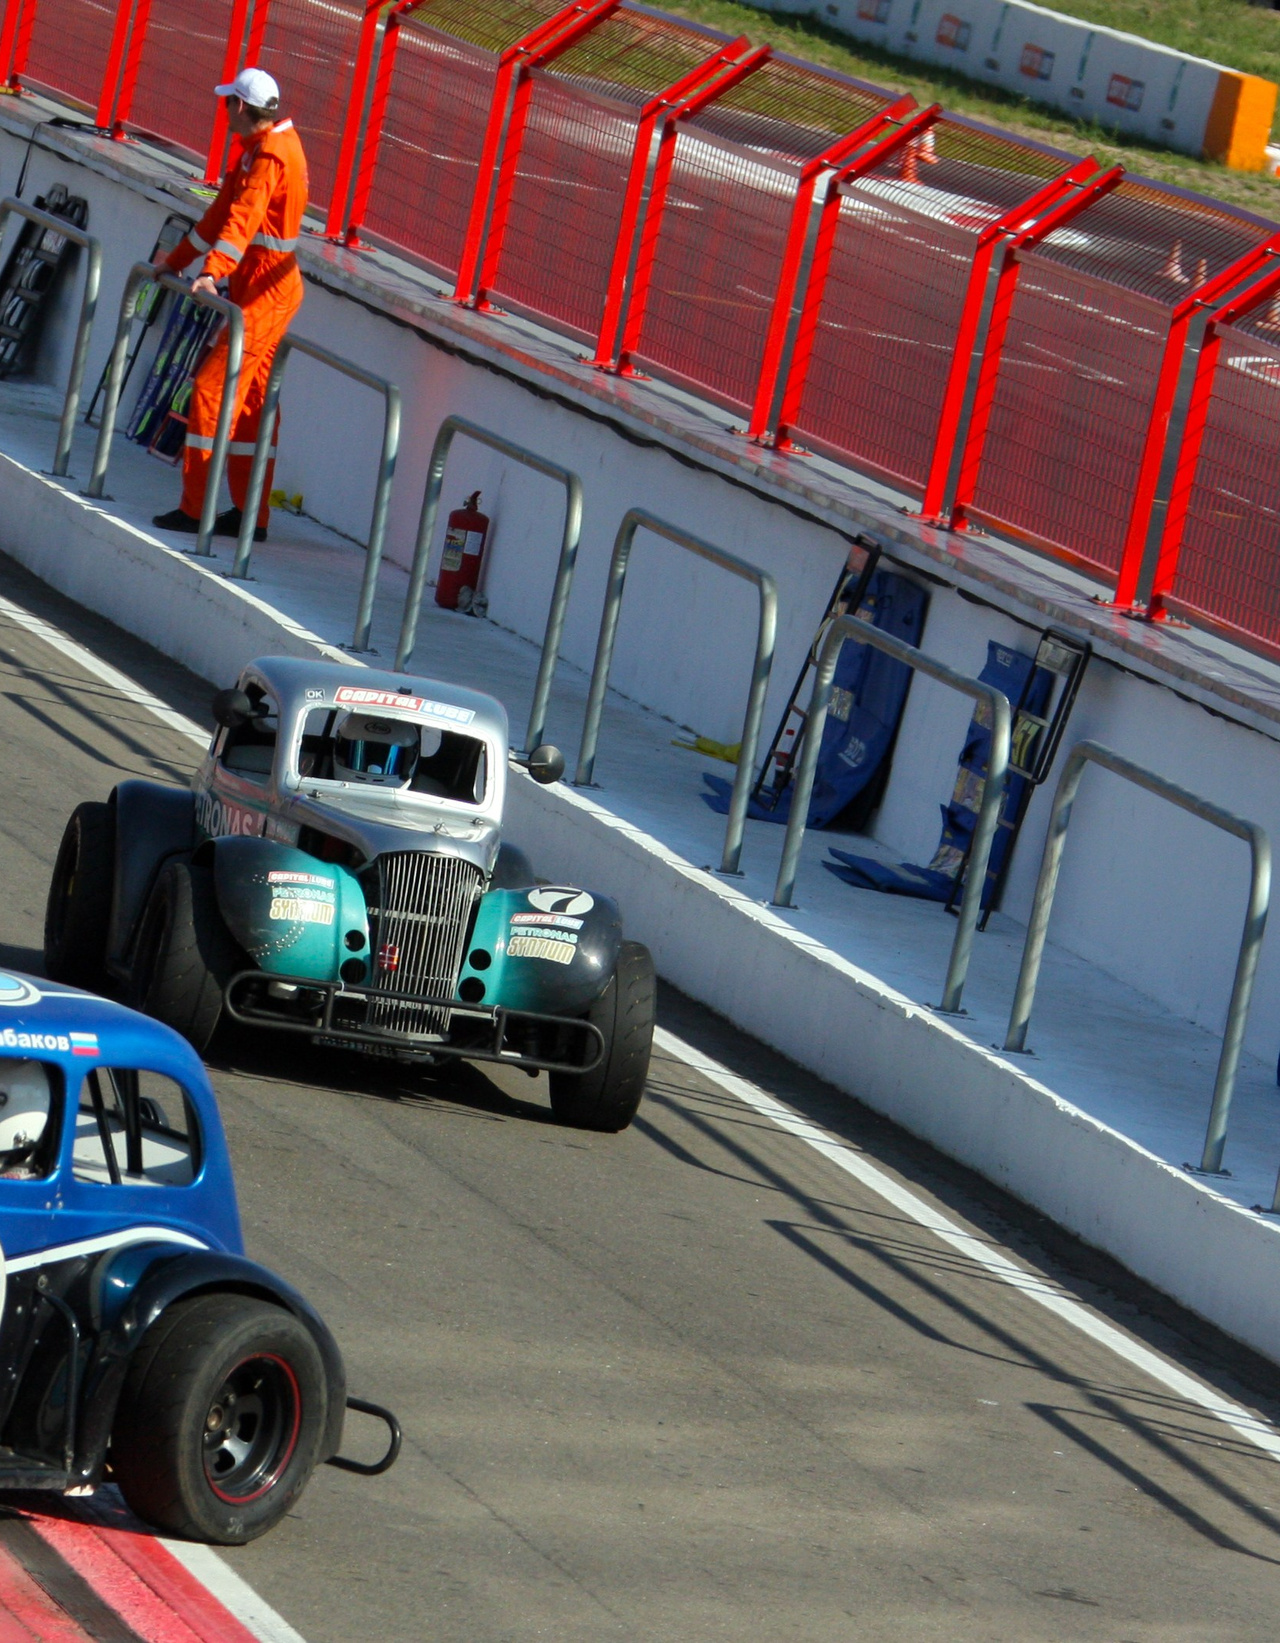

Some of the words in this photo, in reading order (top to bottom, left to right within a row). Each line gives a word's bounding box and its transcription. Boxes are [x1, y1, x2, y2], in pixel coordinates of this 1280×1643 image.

[306, 689, 323, 699] OK
[339, 690, 419, 709] CAPITAL
[423, 701, 472, 722] LUBE
[270, 872, 309, 882] CAPITAL
[272, 886, 336, 904] PETRONAS
[538, 887, 583, 913] 7
[513, 914, 554, 923] CAPITAL
[509, 926, 578, 944] PETRONAS
[506, 936, 577, 965] SYNTIUM
